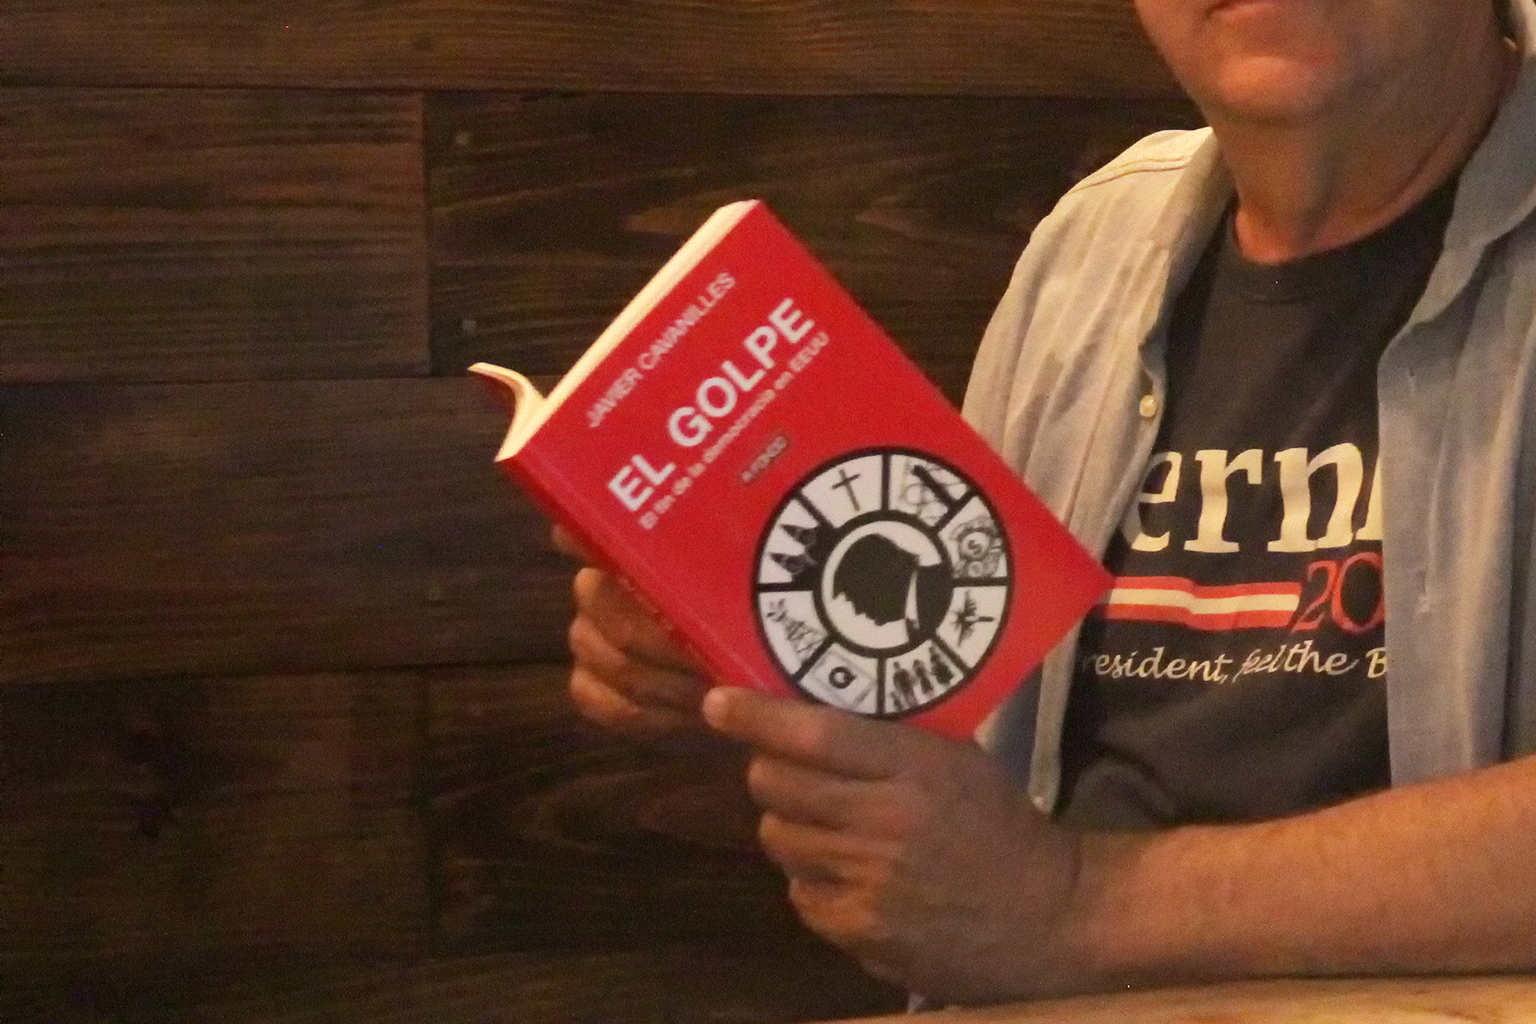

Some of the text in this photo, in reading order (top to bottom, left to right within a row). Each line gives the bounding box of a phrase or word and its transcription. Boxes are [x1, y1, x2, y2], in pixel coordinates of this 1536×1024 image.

[587, 272, 736, 428] JAVIER CAVANILLES
[607, 454, 676, 512] EL
[667, 297, 815, 448] GOLPE
[1284, 640, 1360, 676] the
